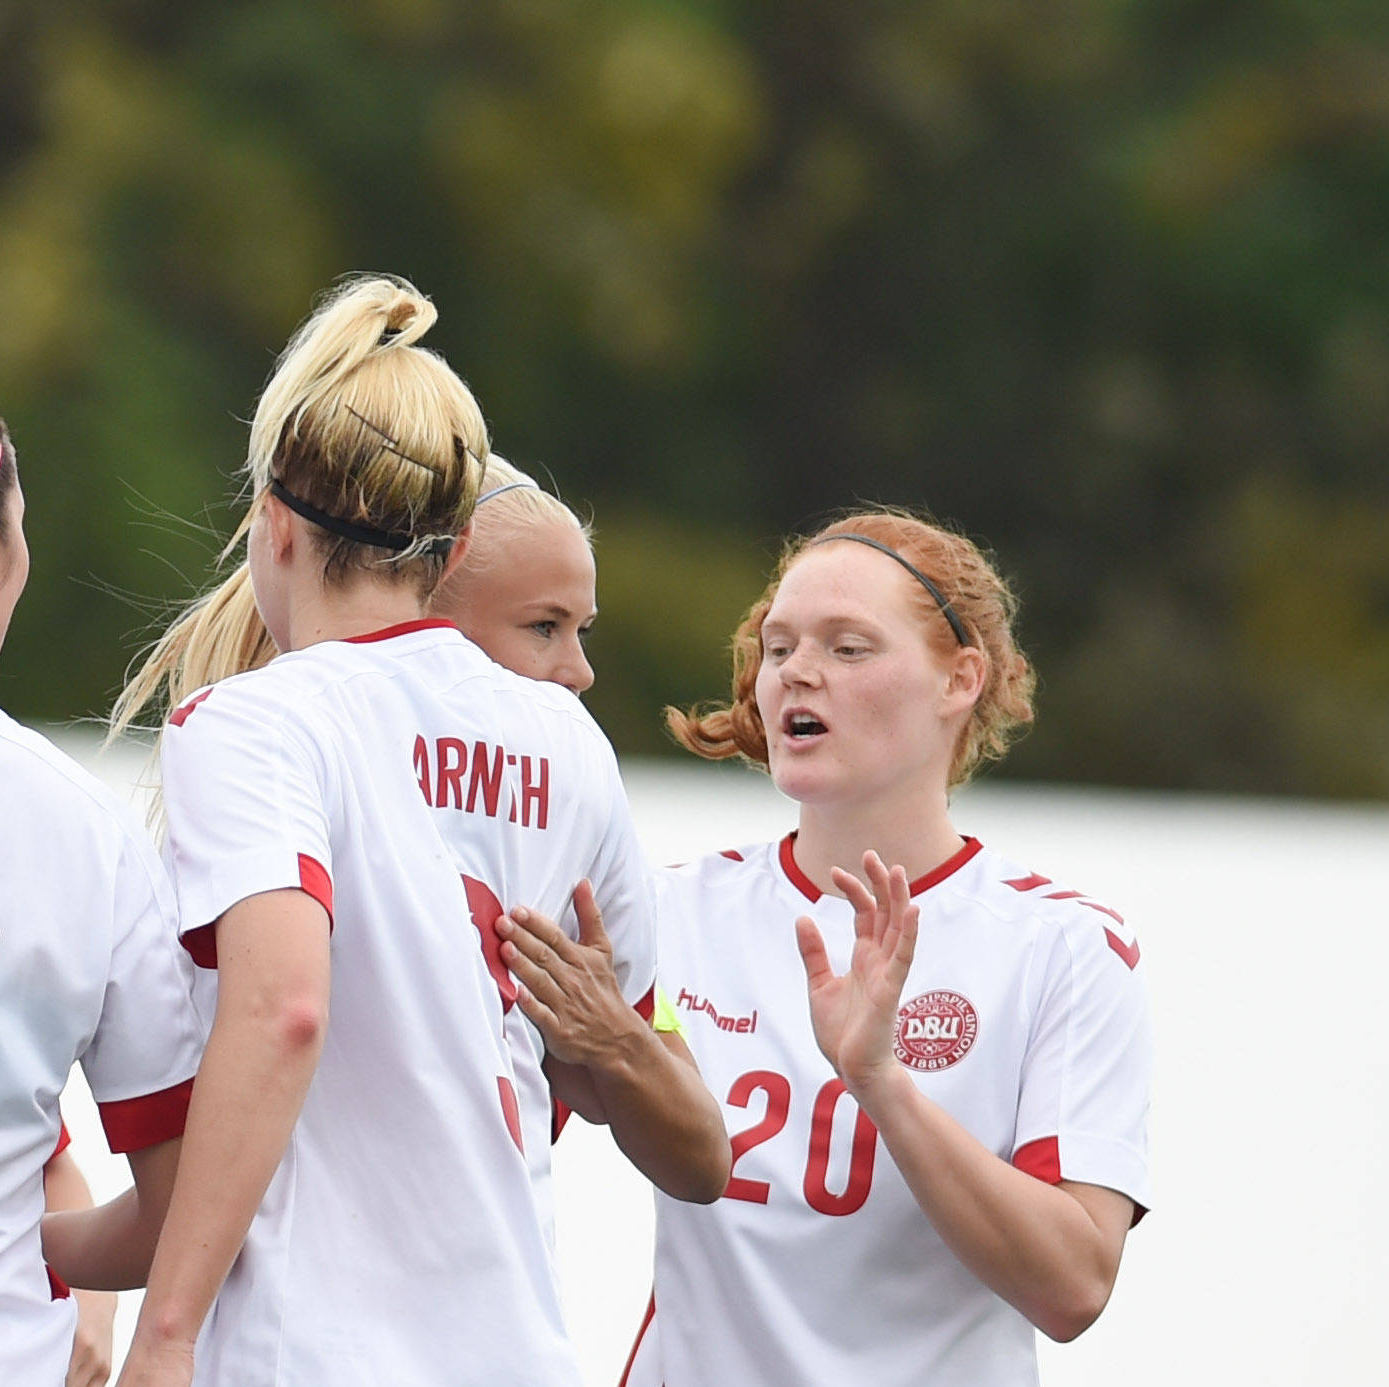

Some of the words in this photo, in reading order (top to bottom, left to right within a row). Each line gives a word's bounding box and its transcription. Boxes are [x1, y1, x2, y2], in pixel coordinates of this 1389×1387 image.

[676, 987, 758, 1034] hummel
[903, 1015, 961, 1041] DBU
[909, 1056, 949, 1069] 1889
[722, 1069, 878, 1217] 20
